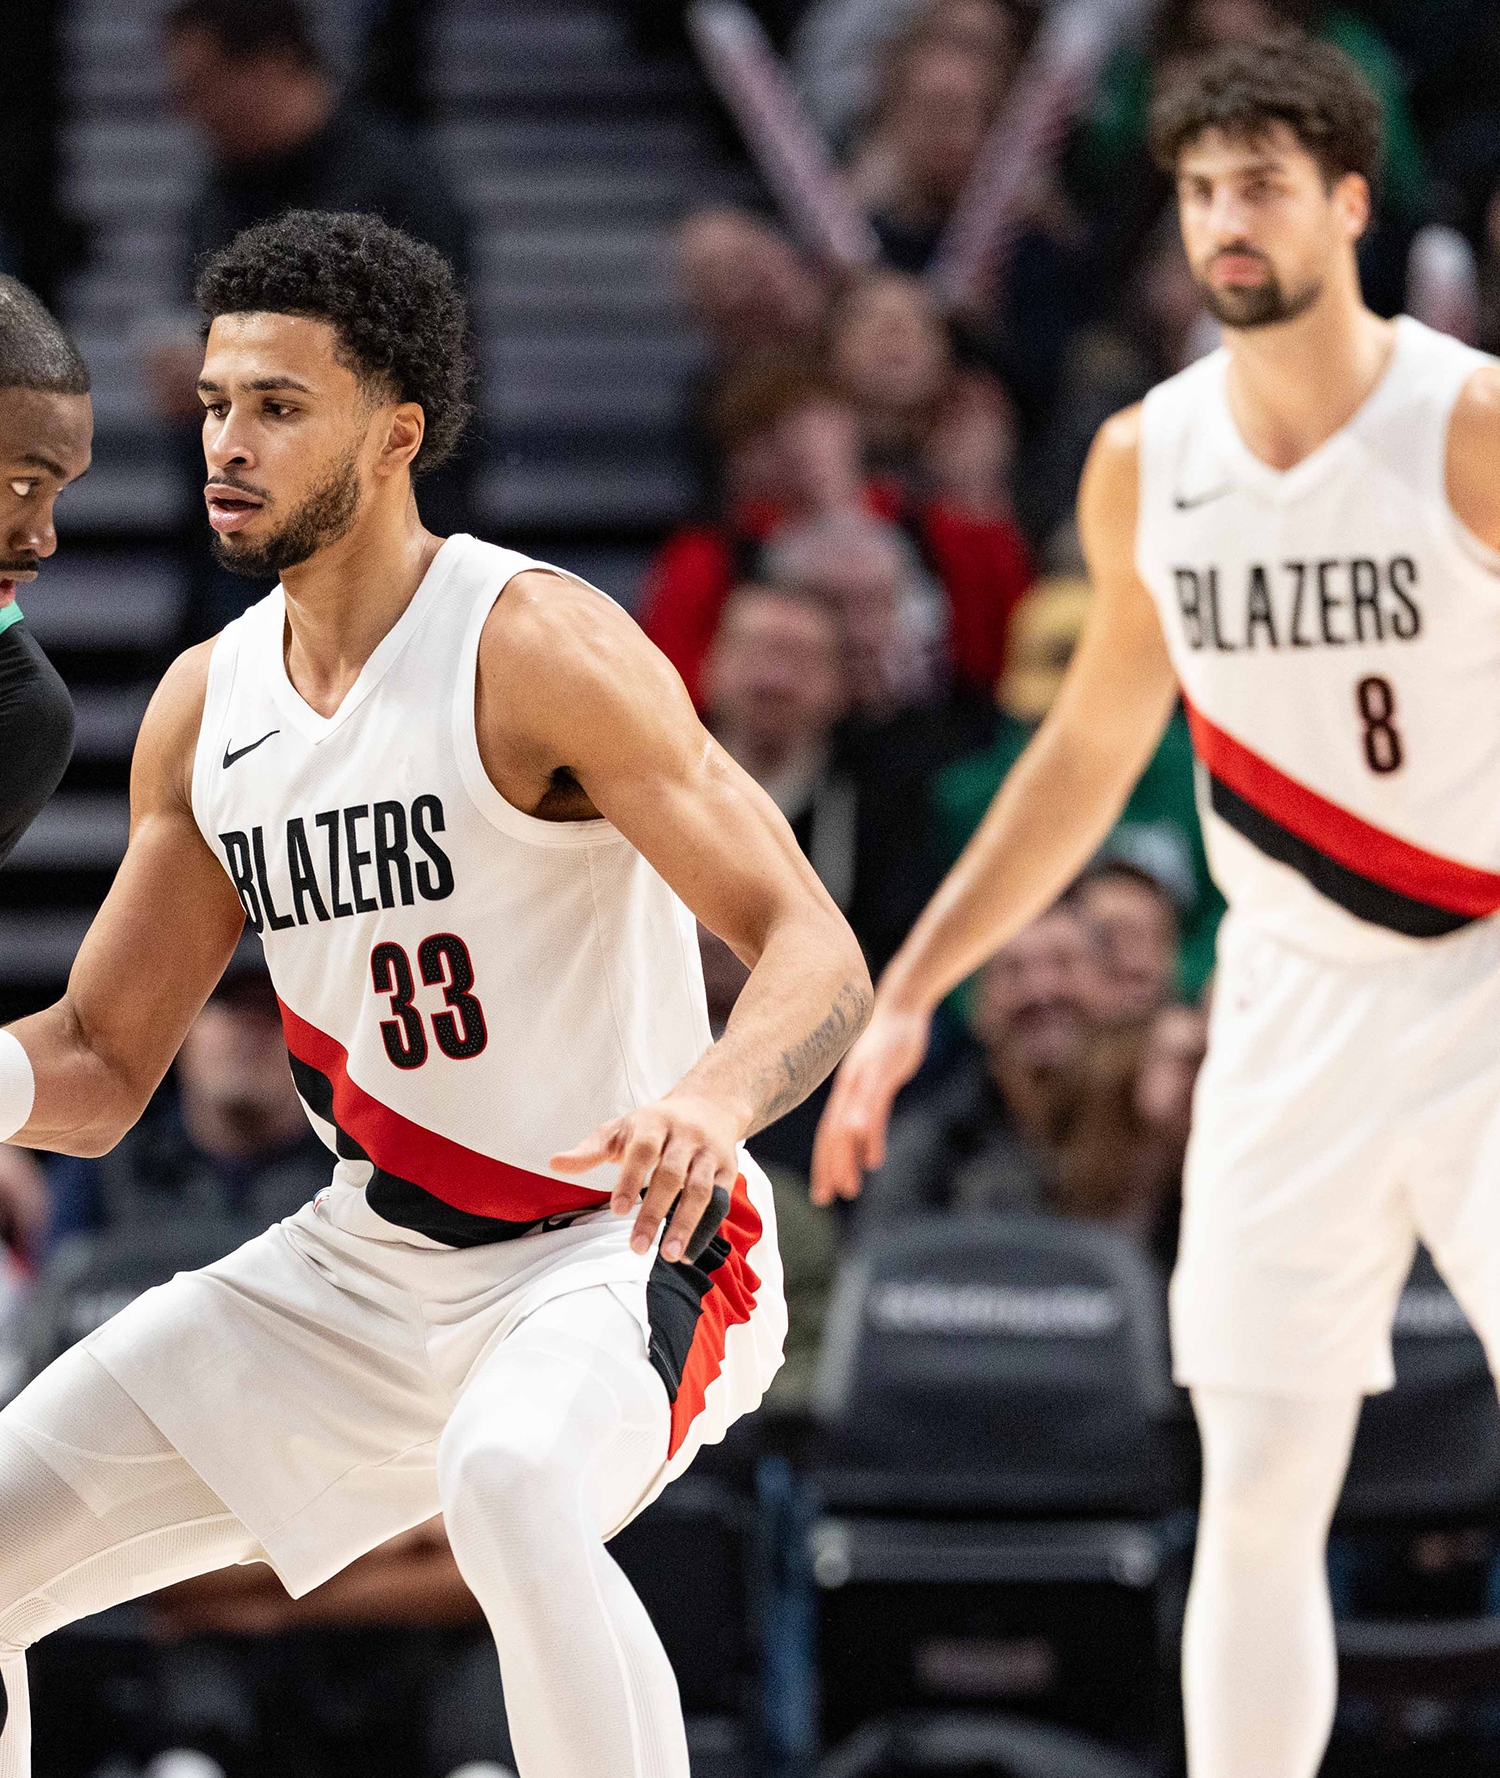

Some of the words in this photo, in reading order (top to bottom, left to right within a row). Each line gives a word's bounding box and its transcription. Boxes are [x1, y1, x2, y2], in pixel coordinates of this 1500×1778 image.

[1173, 555, 1422, 654] BLAZERS
[1355, 672, 1404, 777] 8
[218, 793, 455, 935] BLAZERS
[371, 932, 488, 1070] 33
